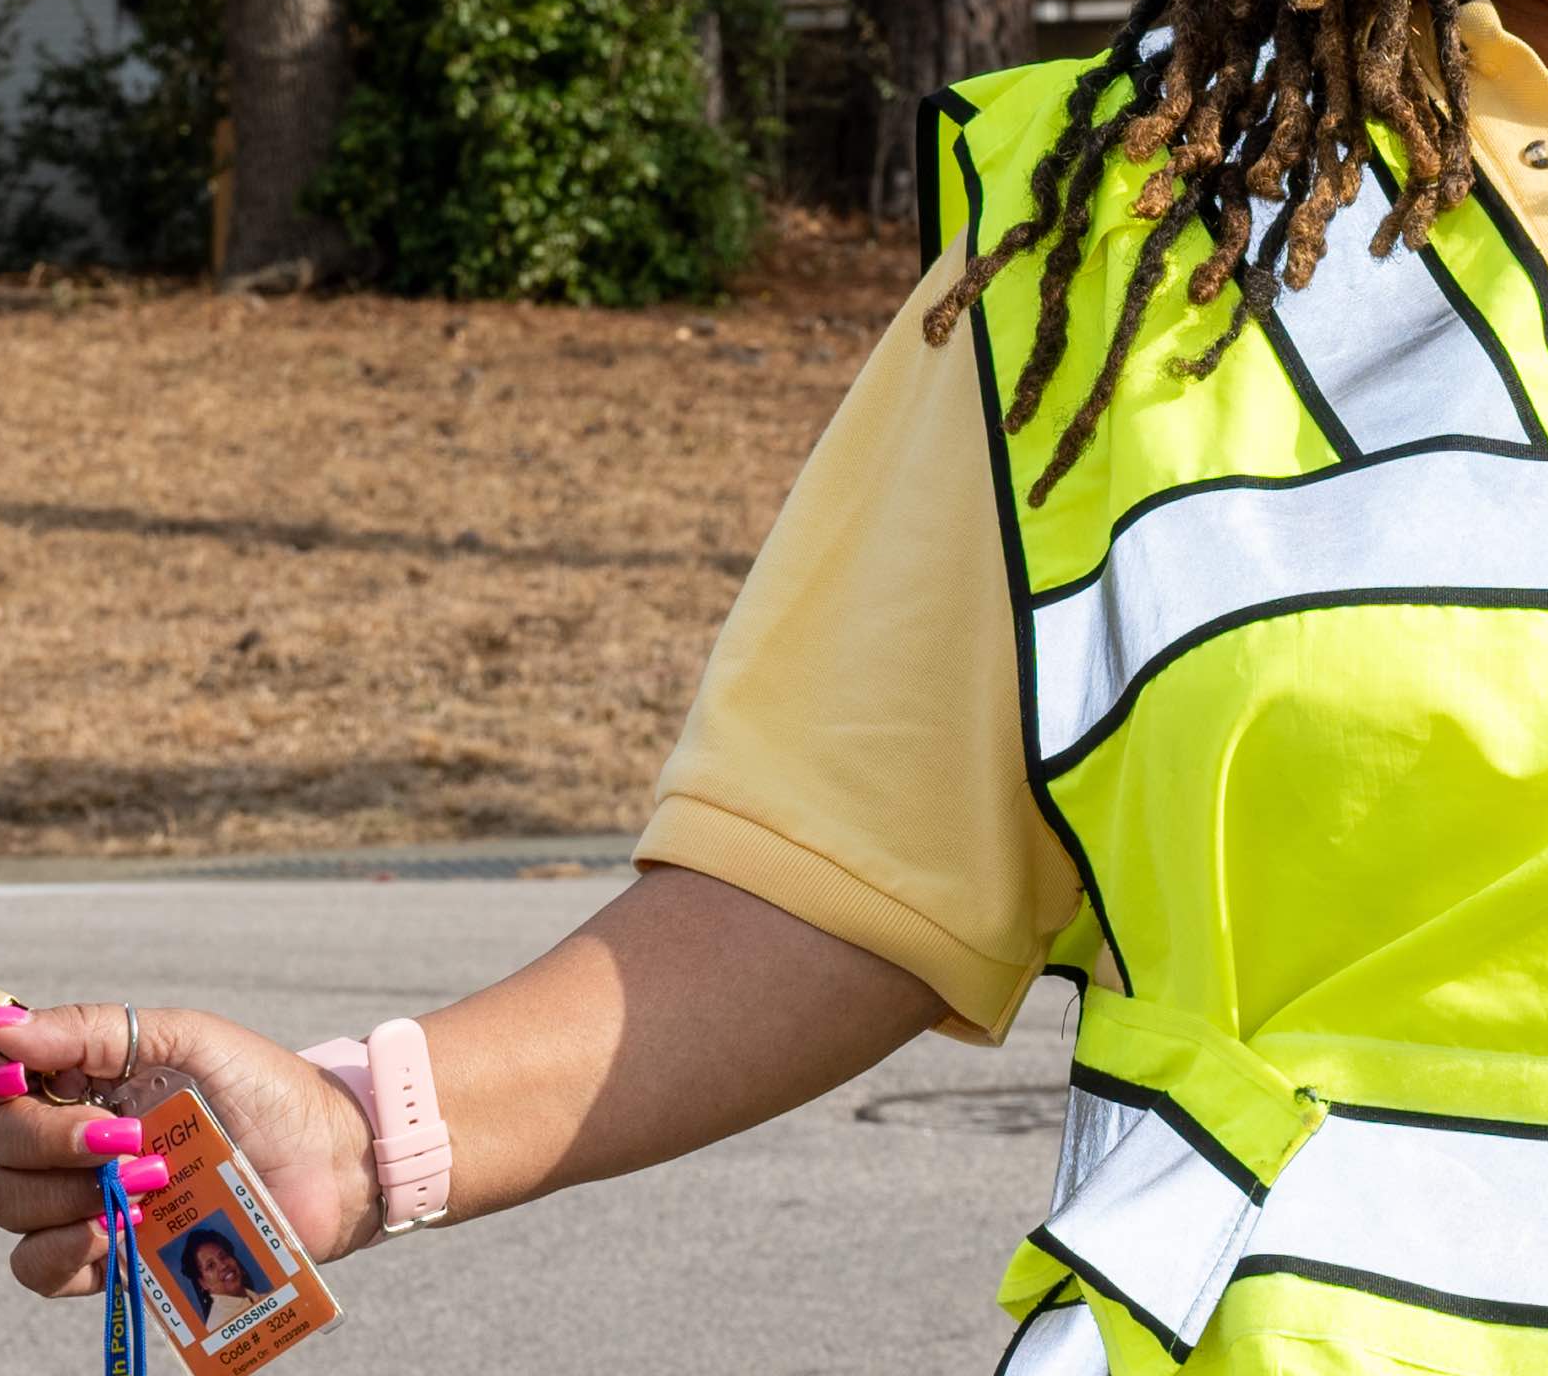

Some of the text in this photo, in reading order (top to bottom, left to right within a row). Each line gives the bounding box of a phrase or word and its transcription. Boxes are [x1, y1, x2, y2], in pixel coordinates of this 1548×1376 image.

[152, 1189, 194, 1222] Sharon
[166, 1207, 199, 1234] REID
[235, 1185, 281, 1250] GUARD
[111, 1283, 127, 1354] Police
[219, 1340, 252, 1365] Code
[266, 1307, 297, 1333] 3204
[220, 1296, 279, 1340] CROSSING
